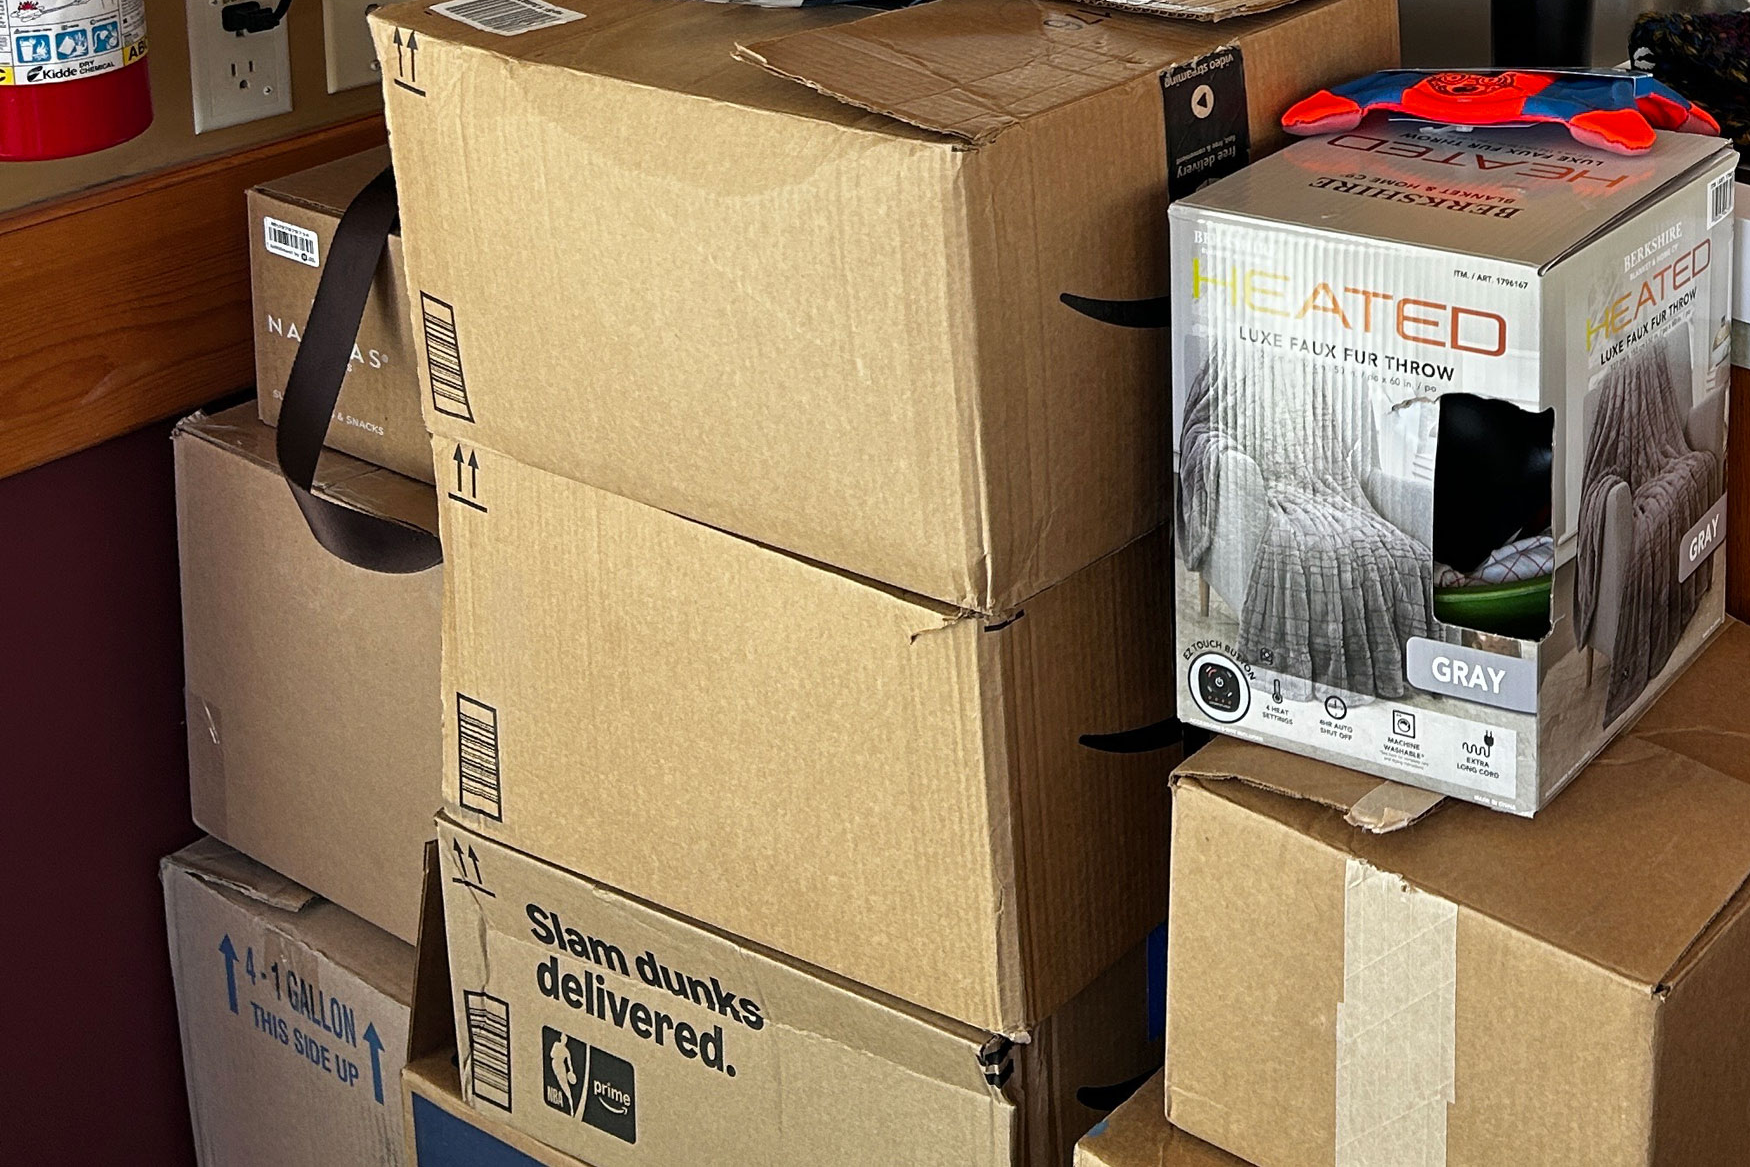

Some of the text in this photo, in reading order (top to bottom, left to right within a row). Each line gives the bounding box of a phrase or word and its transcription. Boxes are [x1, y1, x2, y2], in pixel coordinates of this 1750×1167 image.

[43, 61, 115, 80] Kidde CHEMICAL
[79, 60, 95, 68] DRY
[1164, 53, 1234, 88] video streaming
[1176, 145, 1236, 178] free delivery
[1326, 133, 1629, 188] HEATED
[1398, 132, 1604, 167] LUXE FAUX FUR THROW
[1308, 175, 1525, 220] BERKSHIRE
[1370, 176, 1418, 190] HOME
[1439, 187, 1516, 204] BLANKET
[1623, 221, 1683, 274] BERKSHIRE
[1453, 269, 1469, 279] ITM.
[1477, 274, 1494, 284] ART.
[1496, 277, 1529, 289] 1796167
[1585, 238, 1711, 352] HEATED
[1192, 257, 1507, 357] HEATED
[1600, 340, 1624, 366] LUXE
[1626, 321, 1649, 348] FAUX
[1651, 309, 1667, 331] FUR
[1668, 286, 1698, 316] THROW
[1239, 325, 1455, 382] LUXE FAUX FUR THROW
[1389, 376, 1402, 387] 60
[337, 412, 384, 436] & SNACKS
[1689, 513, 1719, 562] GRAY
[1183, 639, 1256, 681] EZ TOUCH BUTTON
[1431, 656, 1506, 694] GRAY
[1262, 712, 1294, 725] SETTINGS
[1271, 706, 1289, 716] HEAT
[1334, 722, 1353, 733] AUTO
[1320, 727, 1353, 741] SHUT OFF
[1387, 736, 1421, 751] MACHINE
[1456, 763, 1500, 779] LONG CORD
[1466, 756, 1490, 768] EXTRA
[525, 903, 765, 1030] Slam dunks
[286, 969, 357, 1048] GALLON
[536, 955, 737, 1077] delivered.
[250, 1001, 359, 1087] THIS SIDE UP
[546, 1084, 564, 1108] NBA
[593, 1079, 631, 1107] prime
